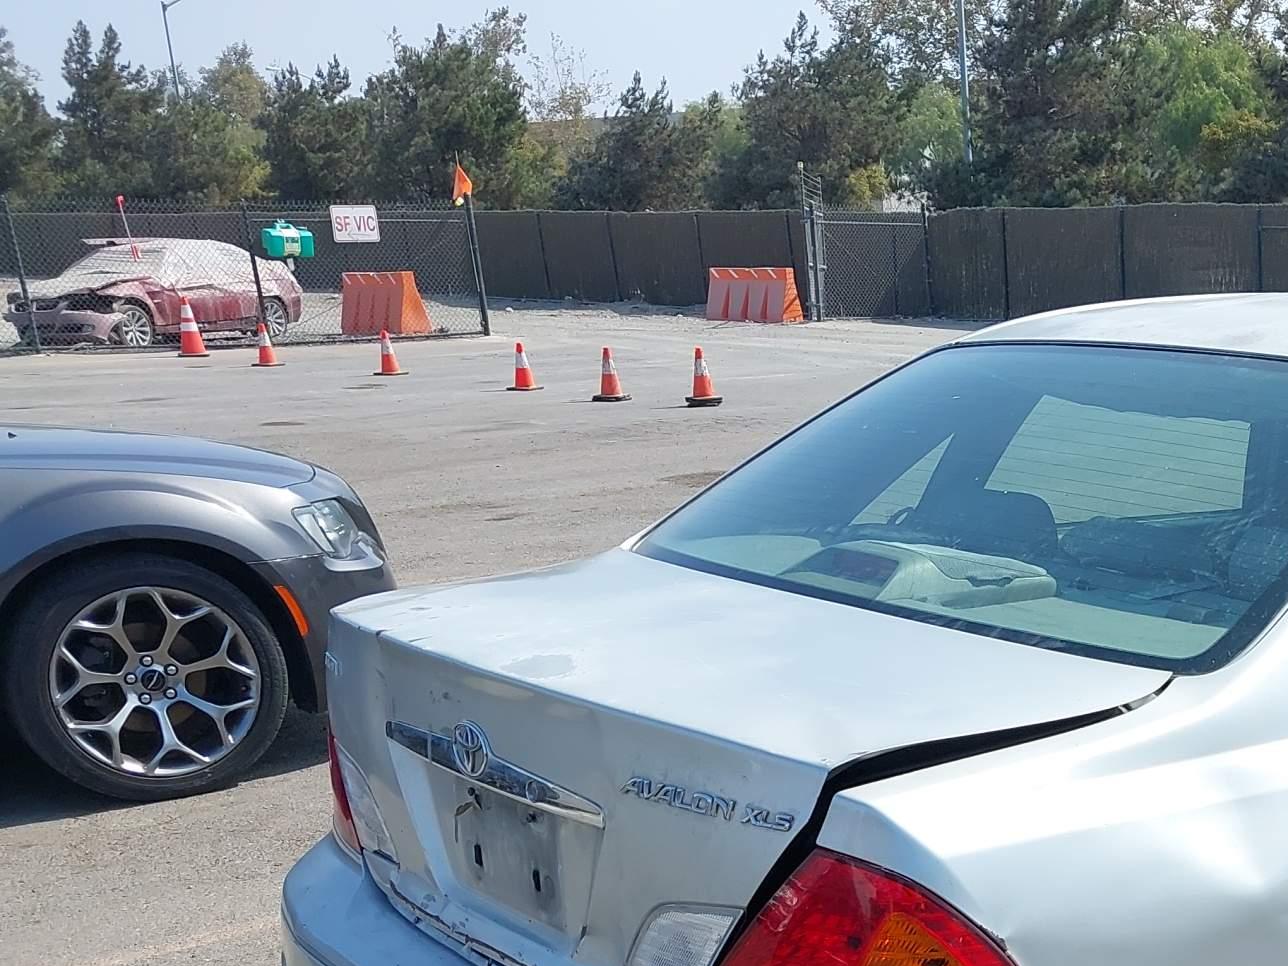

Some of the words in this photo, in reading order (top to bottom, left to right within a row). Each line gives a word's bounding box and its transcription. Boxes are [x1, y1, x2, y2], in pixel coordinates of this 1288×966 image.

[335, 215, 350, 232] SF
[353, 215, 376, 232] VIC
[619, 776, 736, 821] AVALON
[740, 802, 795, 832] XLS
